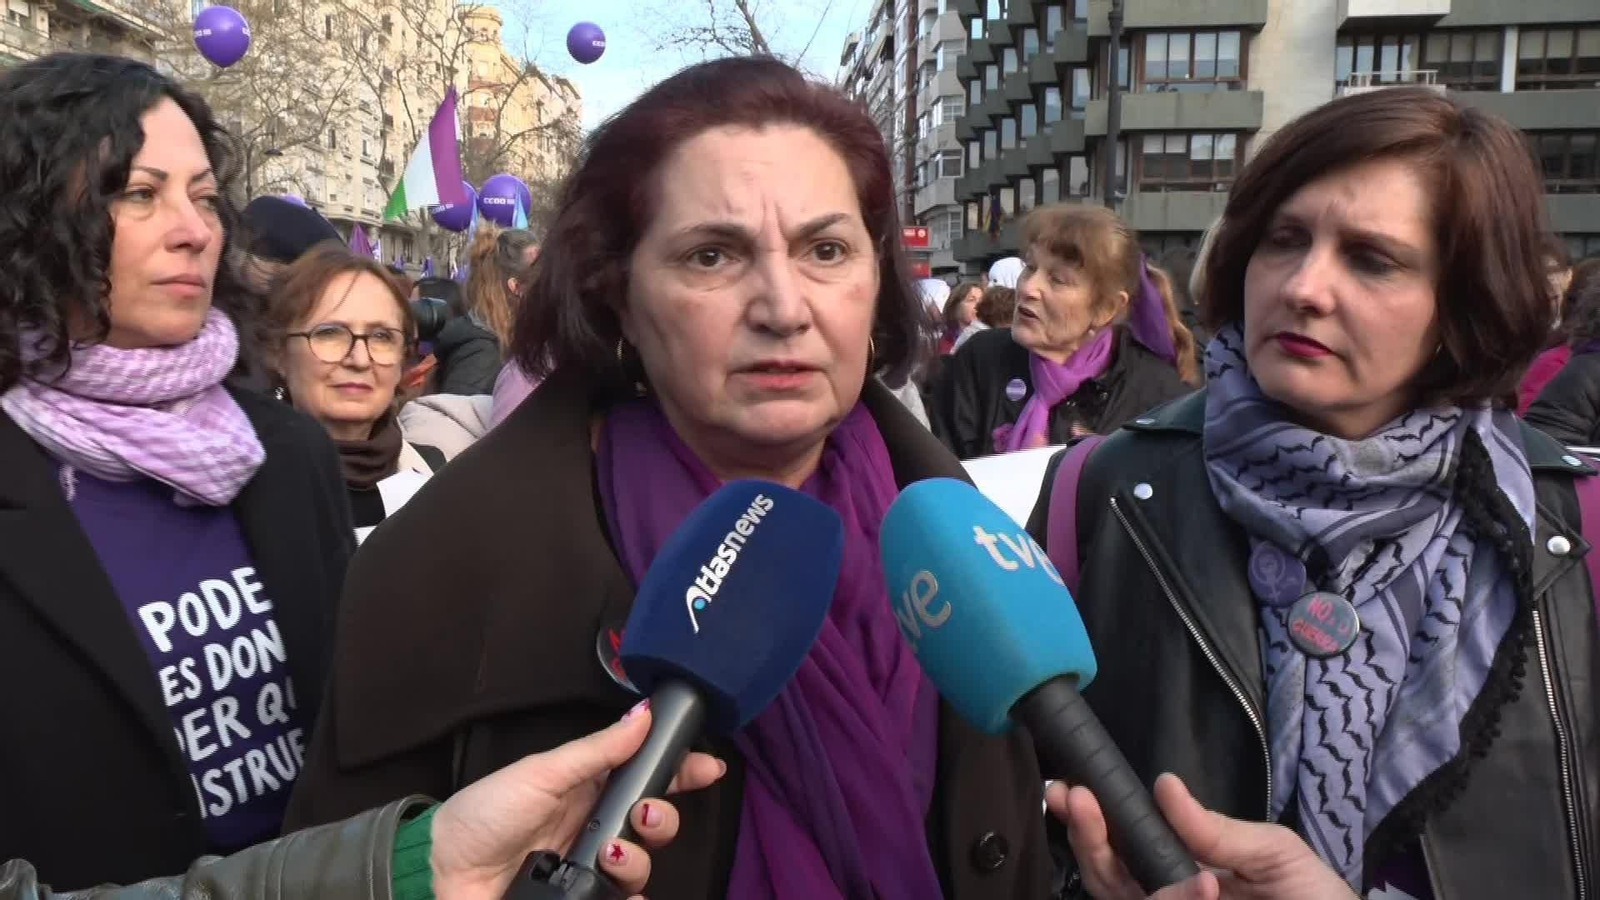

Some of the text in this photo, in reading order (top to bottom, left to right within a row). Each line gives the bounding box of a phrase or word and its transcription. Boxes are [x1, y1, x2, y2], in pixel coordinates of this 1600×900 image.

[686, 493, 774, 634] Atlasnews
[137, 566, 273, 653] PODE
[158, 619, 287, 707] ES DON
[173, 696, 252, 762] ER
[190, 727, 305, 819] STRUE
